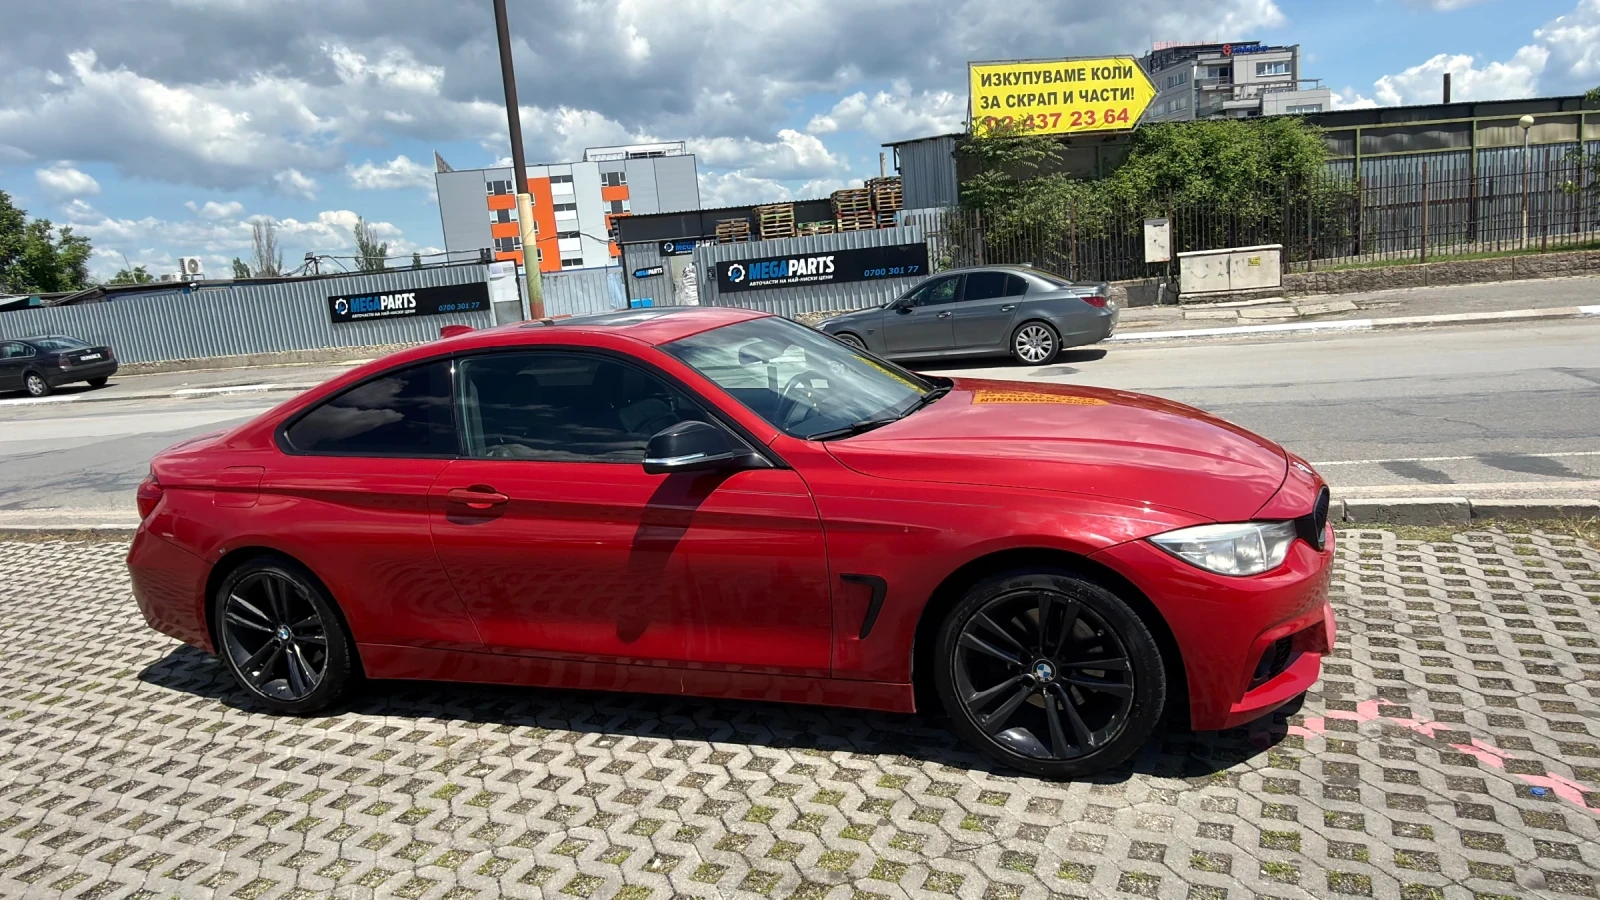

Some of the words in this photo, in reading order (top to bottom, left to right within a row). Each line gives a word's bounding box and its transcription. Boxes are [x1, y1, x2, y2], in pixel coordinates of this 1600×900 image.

[981, 68, 1086, 87] ИЗКУПУВАМЕ
[1091, 66, 1133, 80] КОЛИ
[980, 95, 1001, 109] ЗА
[1006, 92, 1058, 108] СКРАП
[1063, 91, 1074, 104] И
[1079, 87, 1135, 102] ЧАСТИ!
[1023, 112, 1062, 130] 437
[1070, 110, 1097, 126] 23
[1104, 108, 1129, 124] 64
[749, 256, 835, 280] MEGAPARTS
[864, 268, 886, 277] 0700
[888, 266, 905, 275] 301
[908, 265, 919, 273] 77
[350, 293, 417, 313] MEGAPARTS
[438, 304, 456, 312] 0700
[457, 302, 469, 310] 301
[471, 301, 480, 309] 77
